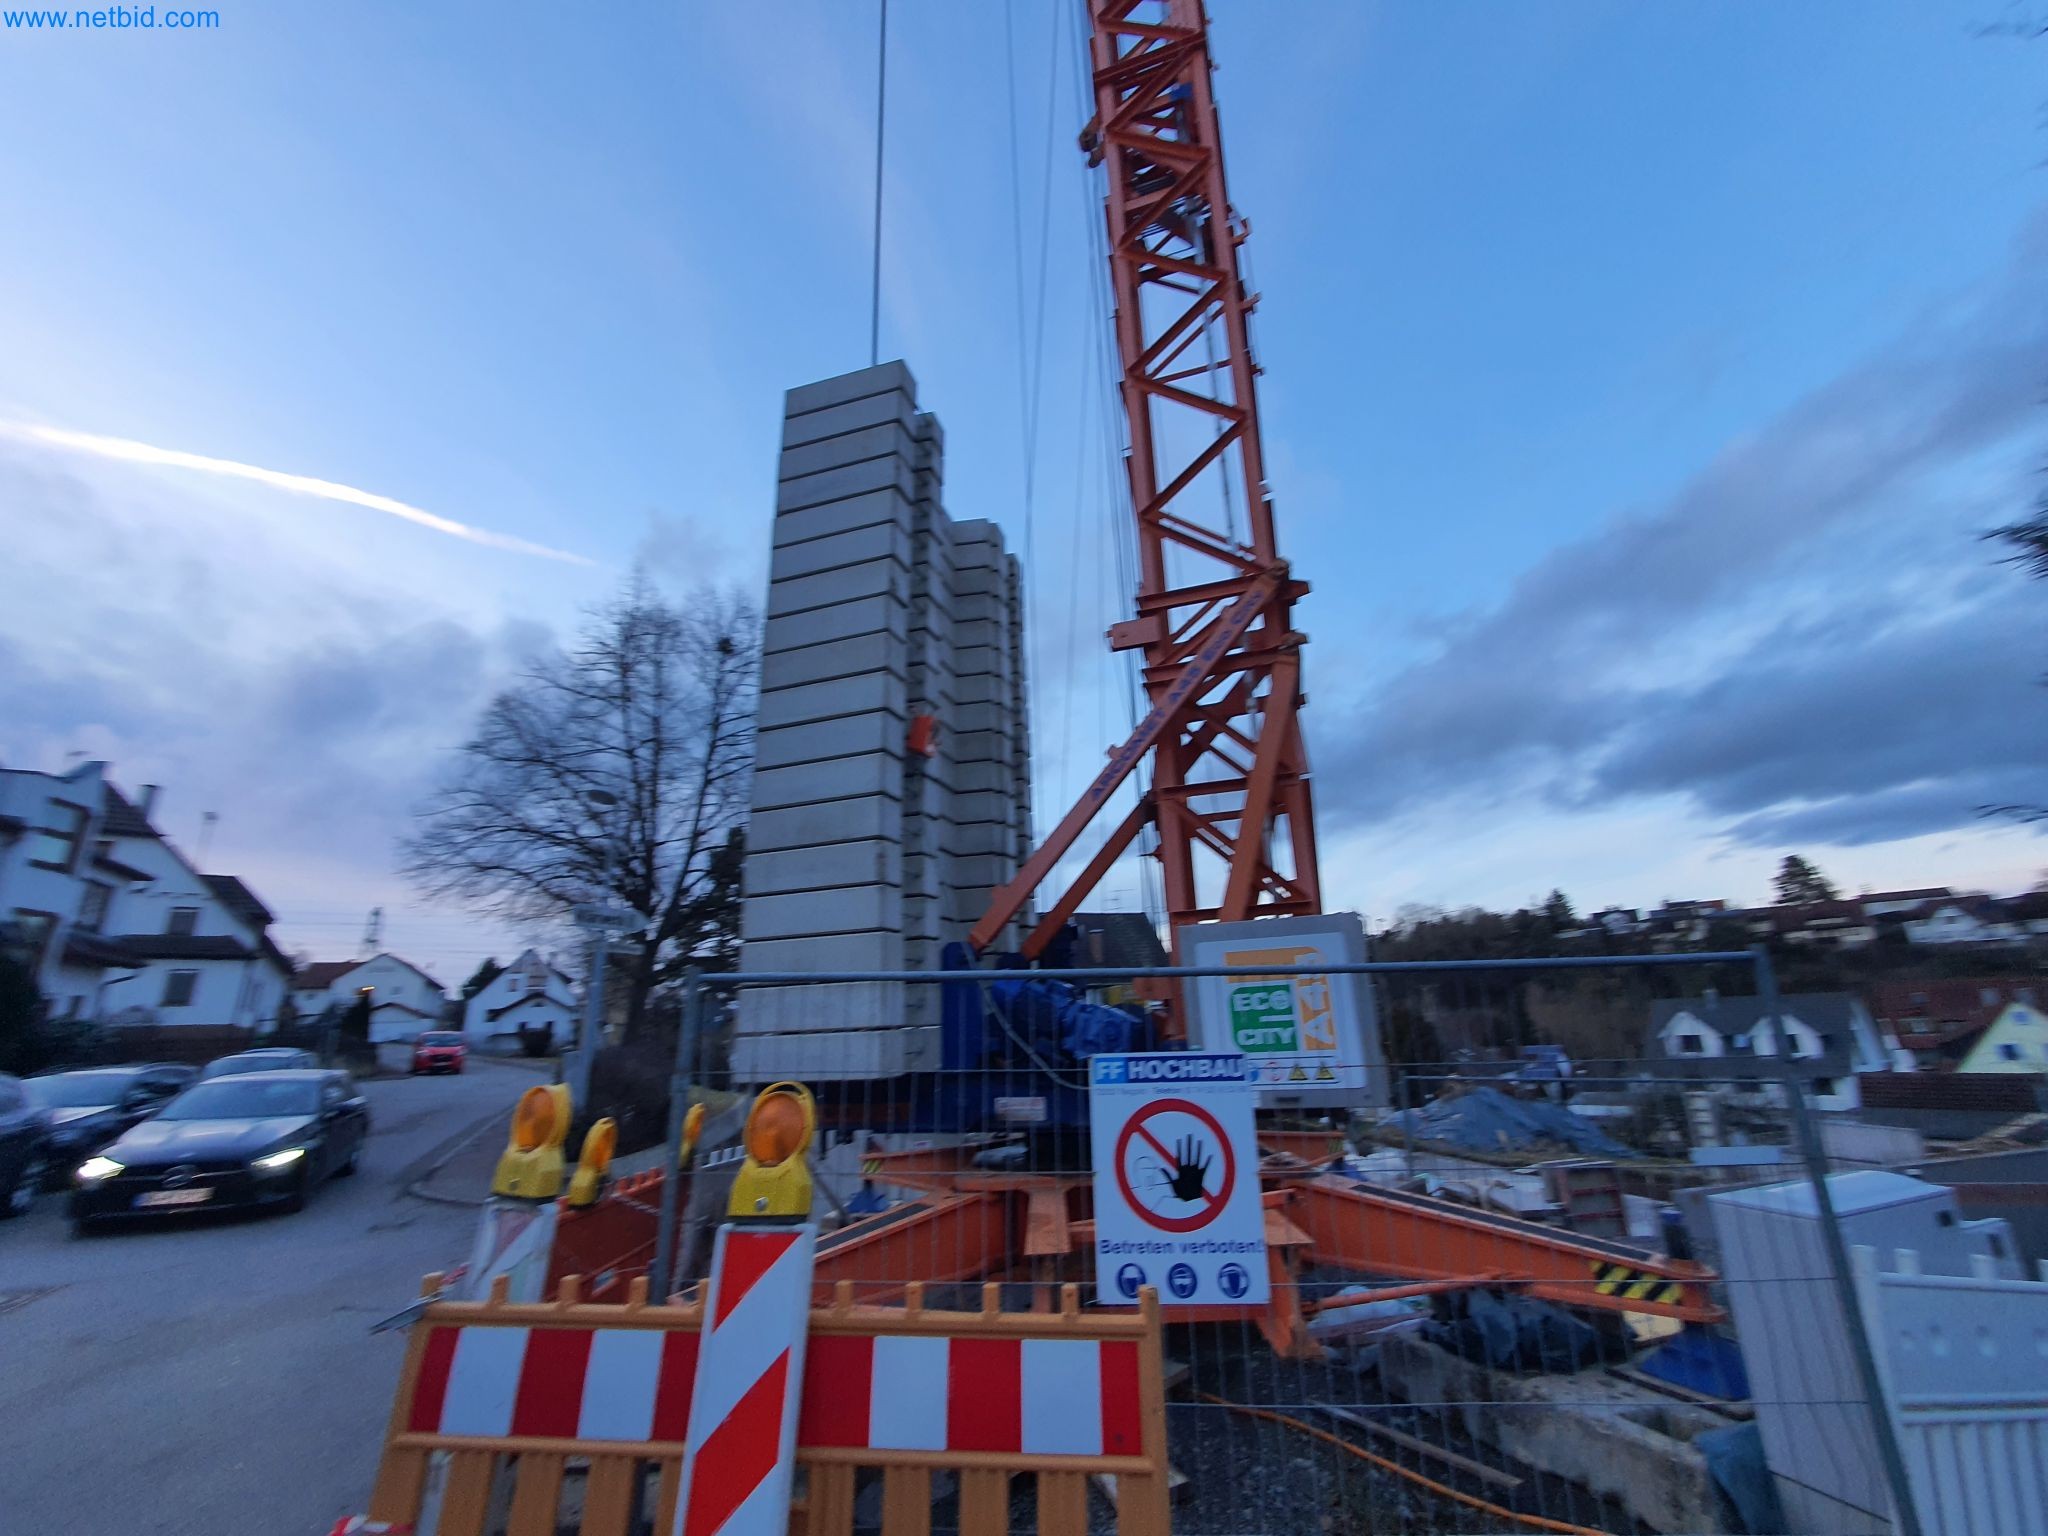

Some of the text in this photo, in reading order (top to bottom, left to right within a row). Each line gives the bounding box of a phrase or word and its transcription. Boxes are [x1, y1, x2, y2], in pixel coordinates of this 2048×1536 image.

[1232, 990, 1291, 1011] ECO
[1237, 1027, 1297, 1046] CITY
[1096, 1058, 1244, 1080] FF HOCHBAU
[1100, 1239, 1173, 1255] Betreten
